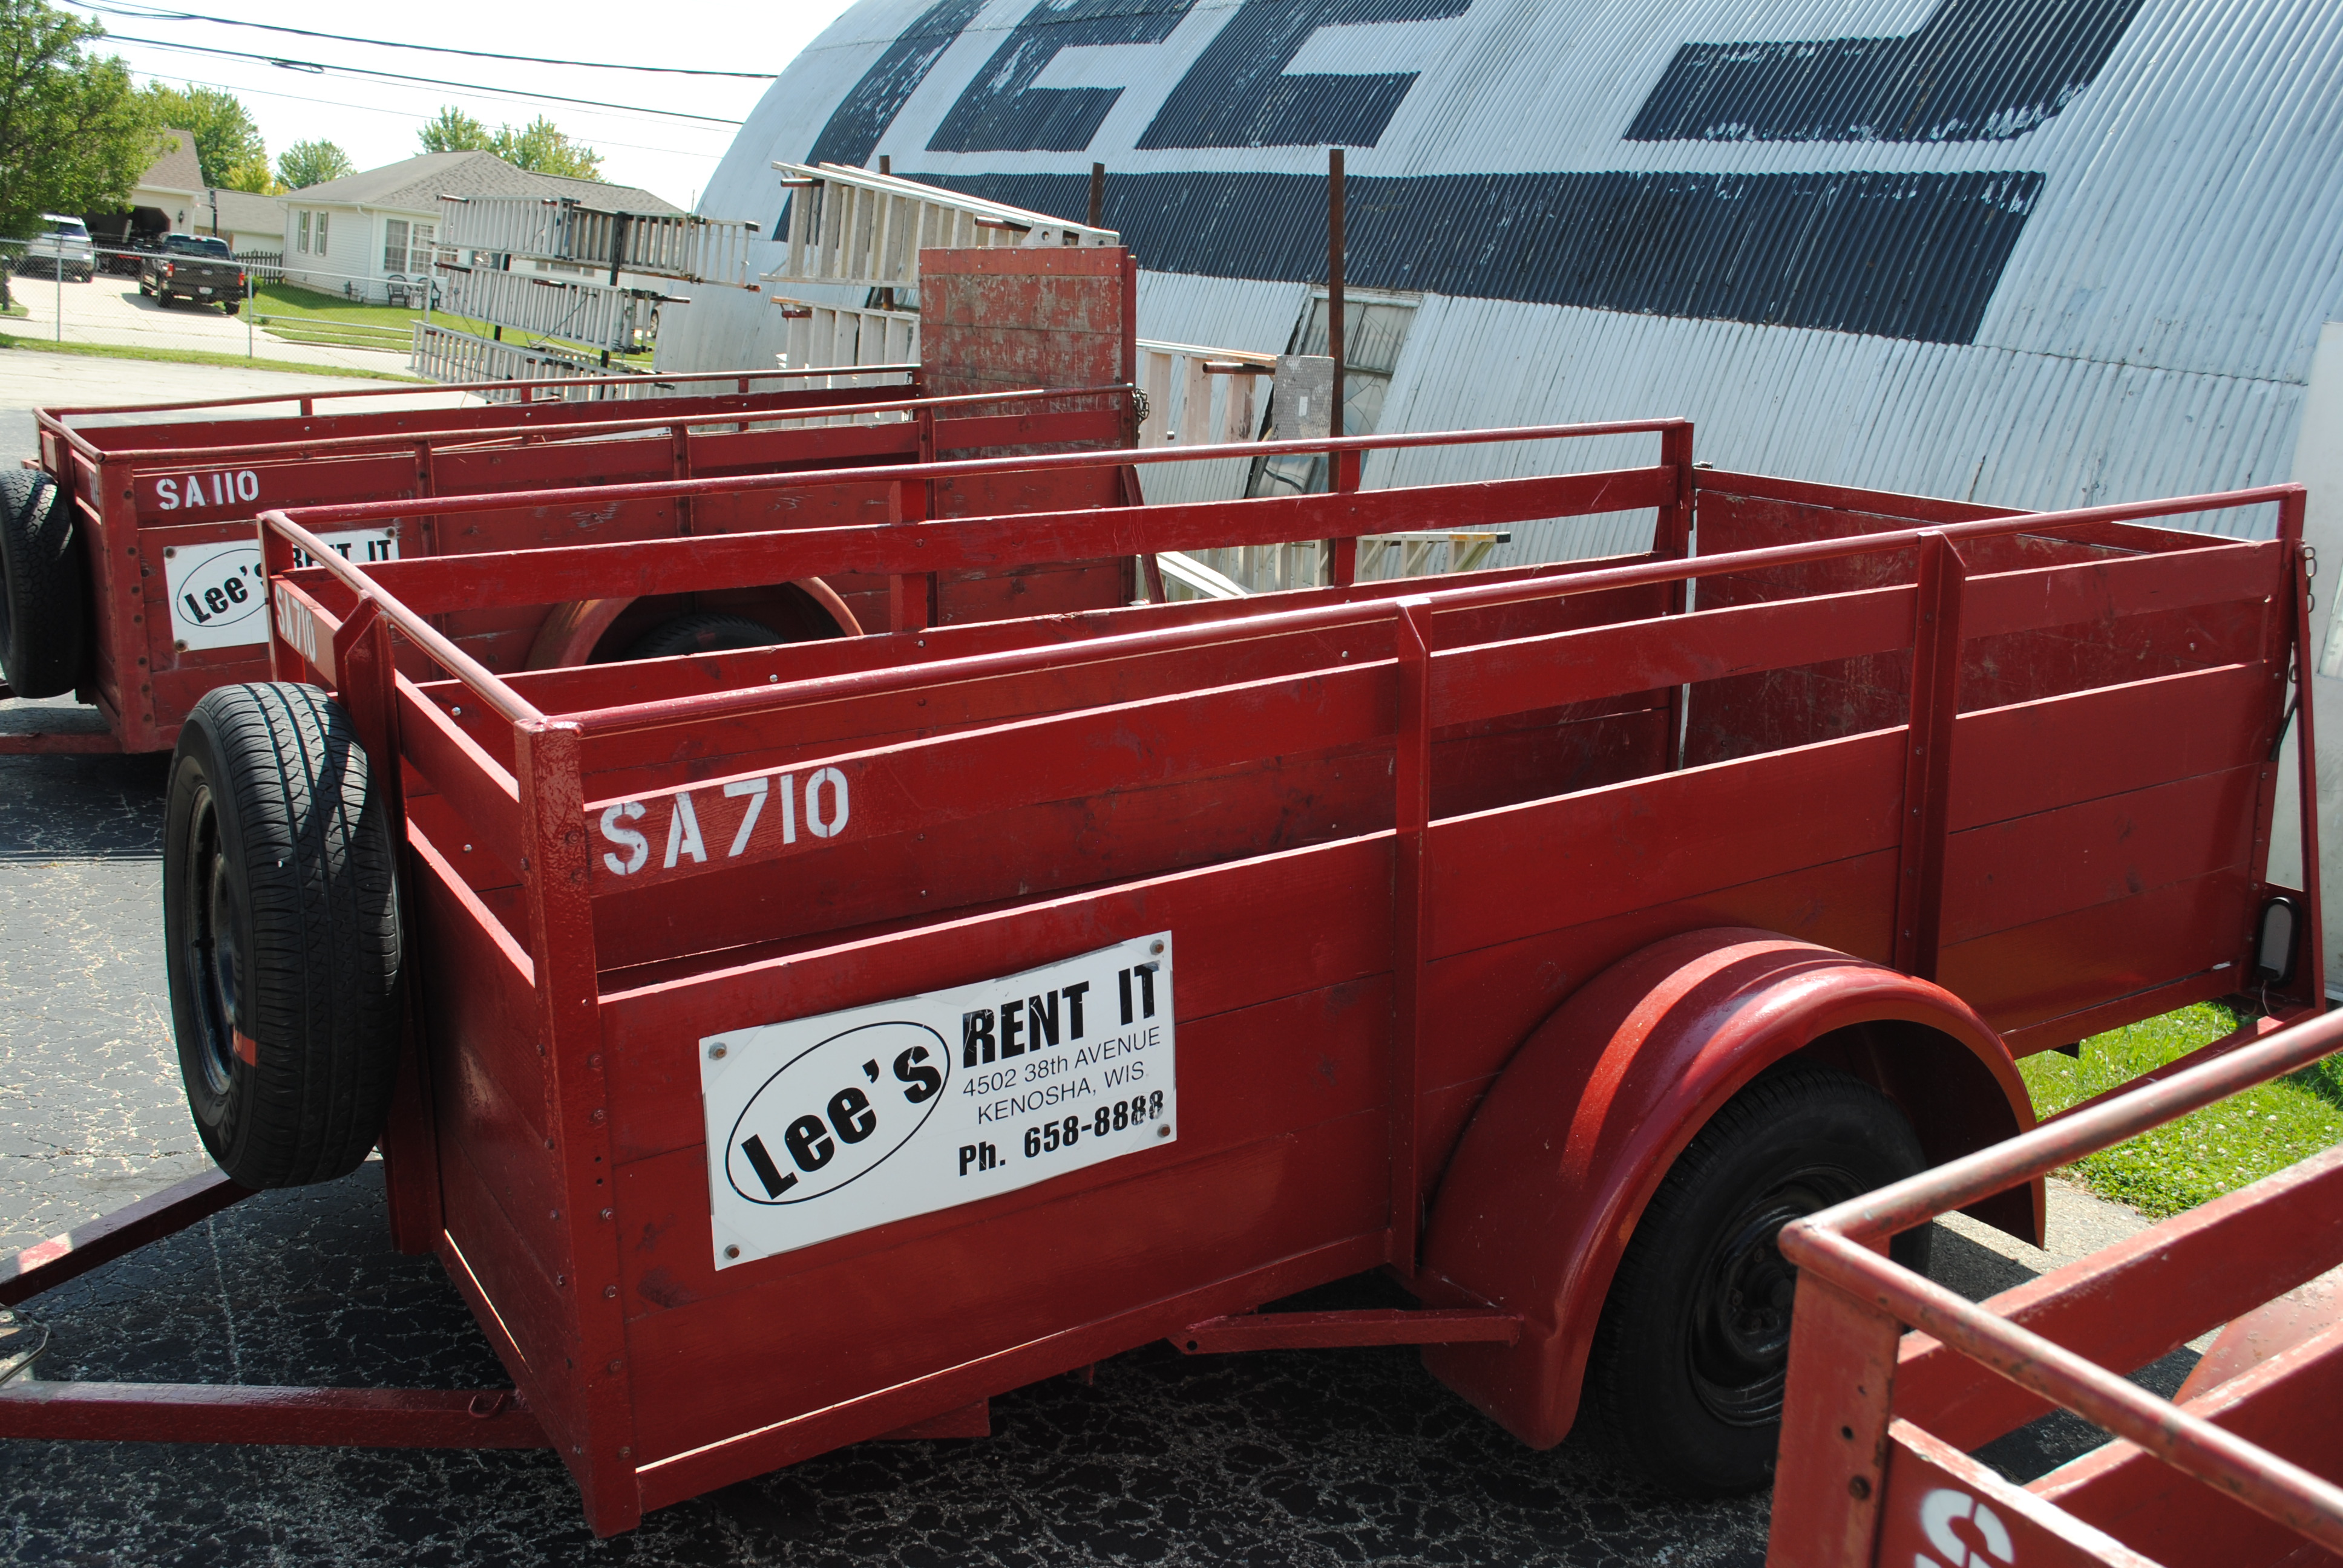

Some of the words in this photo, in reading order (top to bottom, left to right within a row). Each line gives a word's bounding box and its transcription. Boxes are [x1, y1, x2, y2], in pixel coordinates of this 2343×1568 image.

[962, 980, 1090, 1069] RENT
[1118, 961, 1161, 1026] IT
[963, 1067, 1017, 1098] 4502
[1024, 1058, 1068, 1083] 38th
[1075, 1026, 1161, 1071] AVENUE
[978, 1079, 1097, 1125] KENOSHA,
[741, 1045, 942, 1200] Lee's
[959, 1140, 1006, 1177] Ph.
[1024, 1089, 1165, 1158] 658-8888
